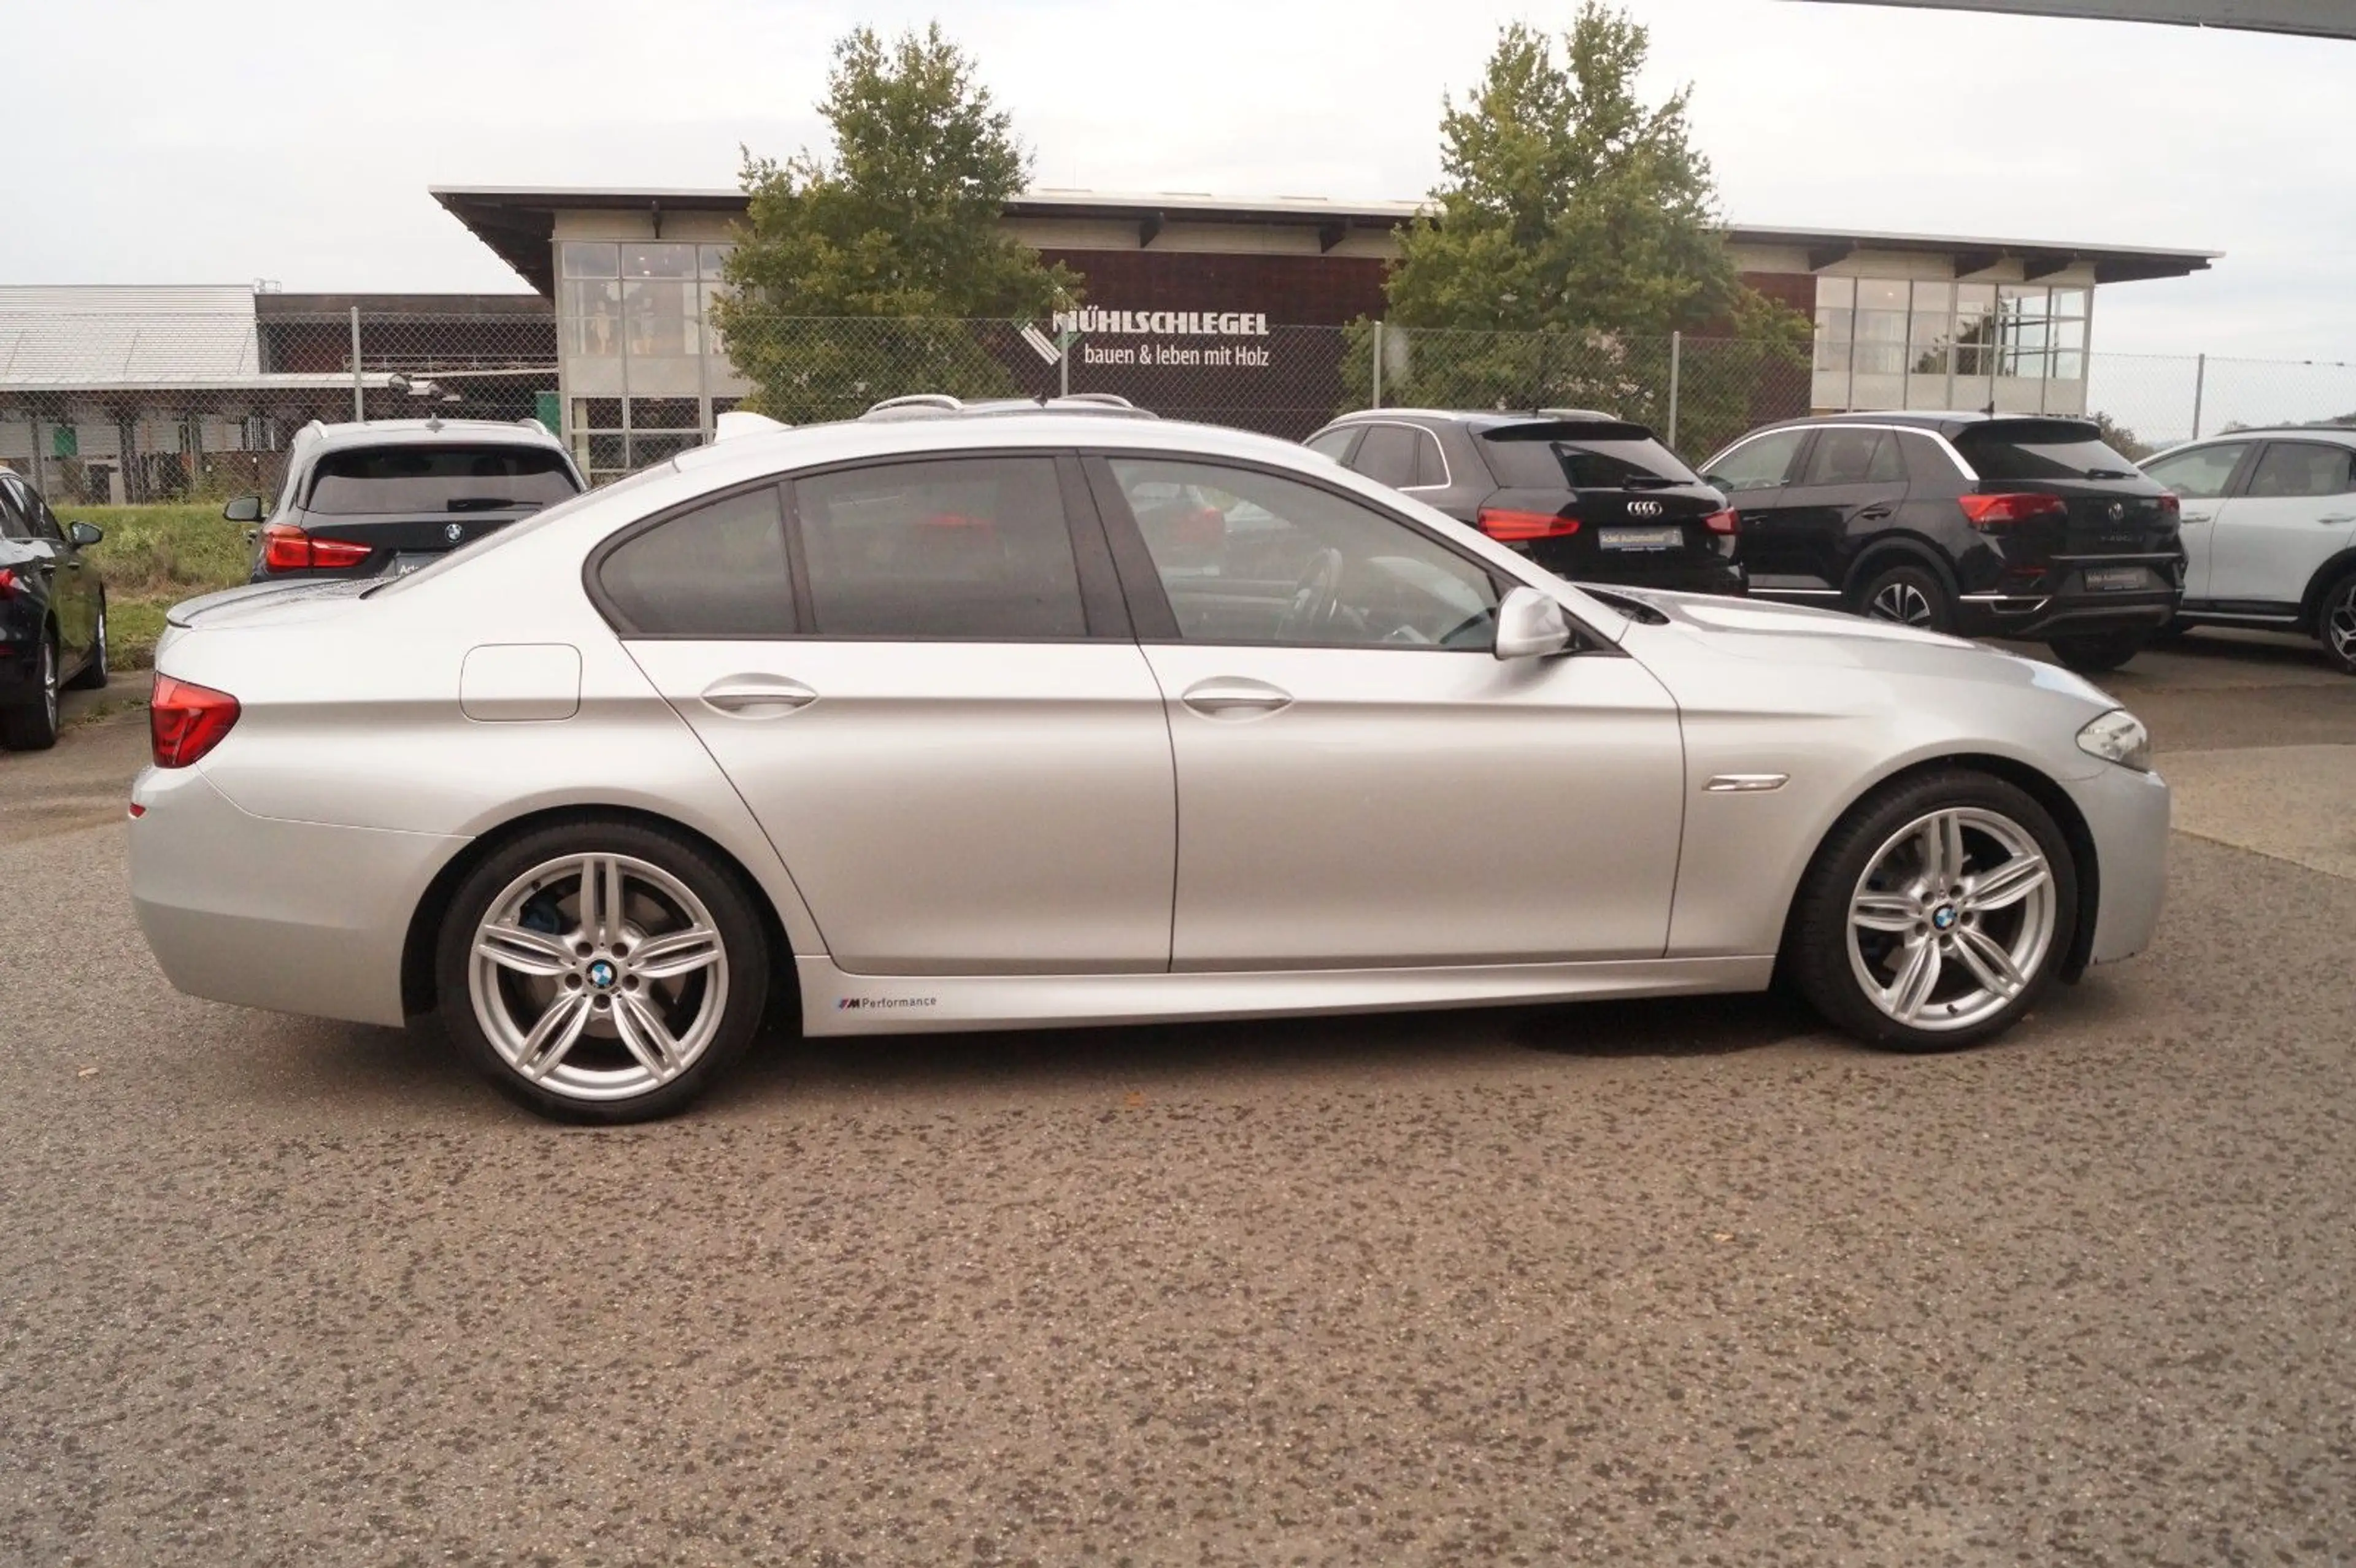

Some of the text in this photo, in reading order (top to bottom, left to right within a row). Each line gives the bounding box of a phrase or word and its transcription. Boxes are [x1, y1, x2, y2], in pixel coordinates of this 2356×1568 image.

[1053, 305, 1269, 335] MÜHLSCHLEGEL
[1085, 343, 1269, 366] bauen & leben mit Holz
[862, 997, 937, 1008] Performance
